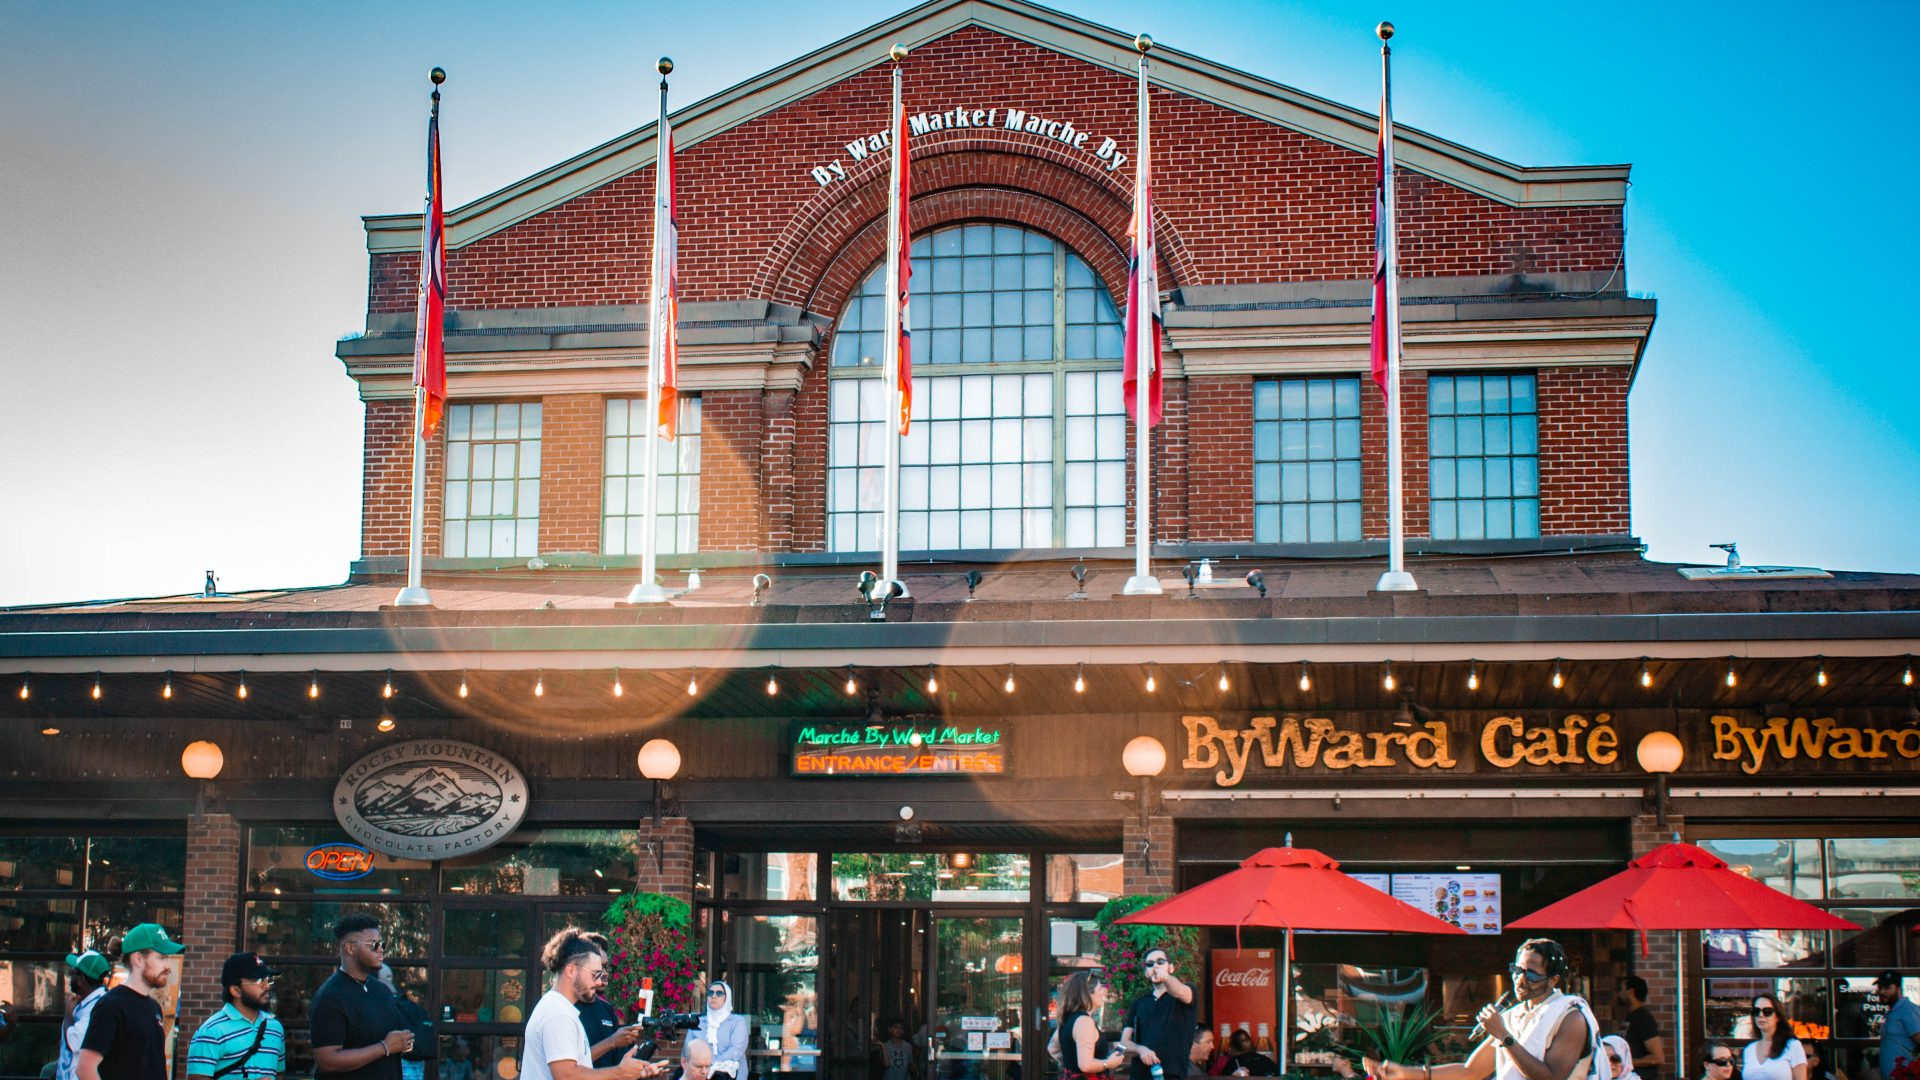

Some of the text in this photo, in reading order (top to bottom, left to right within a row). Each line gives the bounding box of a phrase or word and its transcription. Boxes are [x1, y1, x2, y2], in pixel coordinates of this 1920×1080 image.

[811, 158, 846, 187] By
[845, 128, 893, 161] War
[909, 106, 996, 135] Market
[1096, 137, 1127, 170] By
[798, 727, 860, 745] Marché
[865, 727, 890, 748] By
[939, 727, 1000, 744] Market
[1181, 713, 1618, 787] ByWard Café
[344, 743, 514, 788] ROCKY MOUNTAIN
[344, 813, 511, 852] CHOCOLATE FACTORY
[306, 850, 374, 872] OPEN
